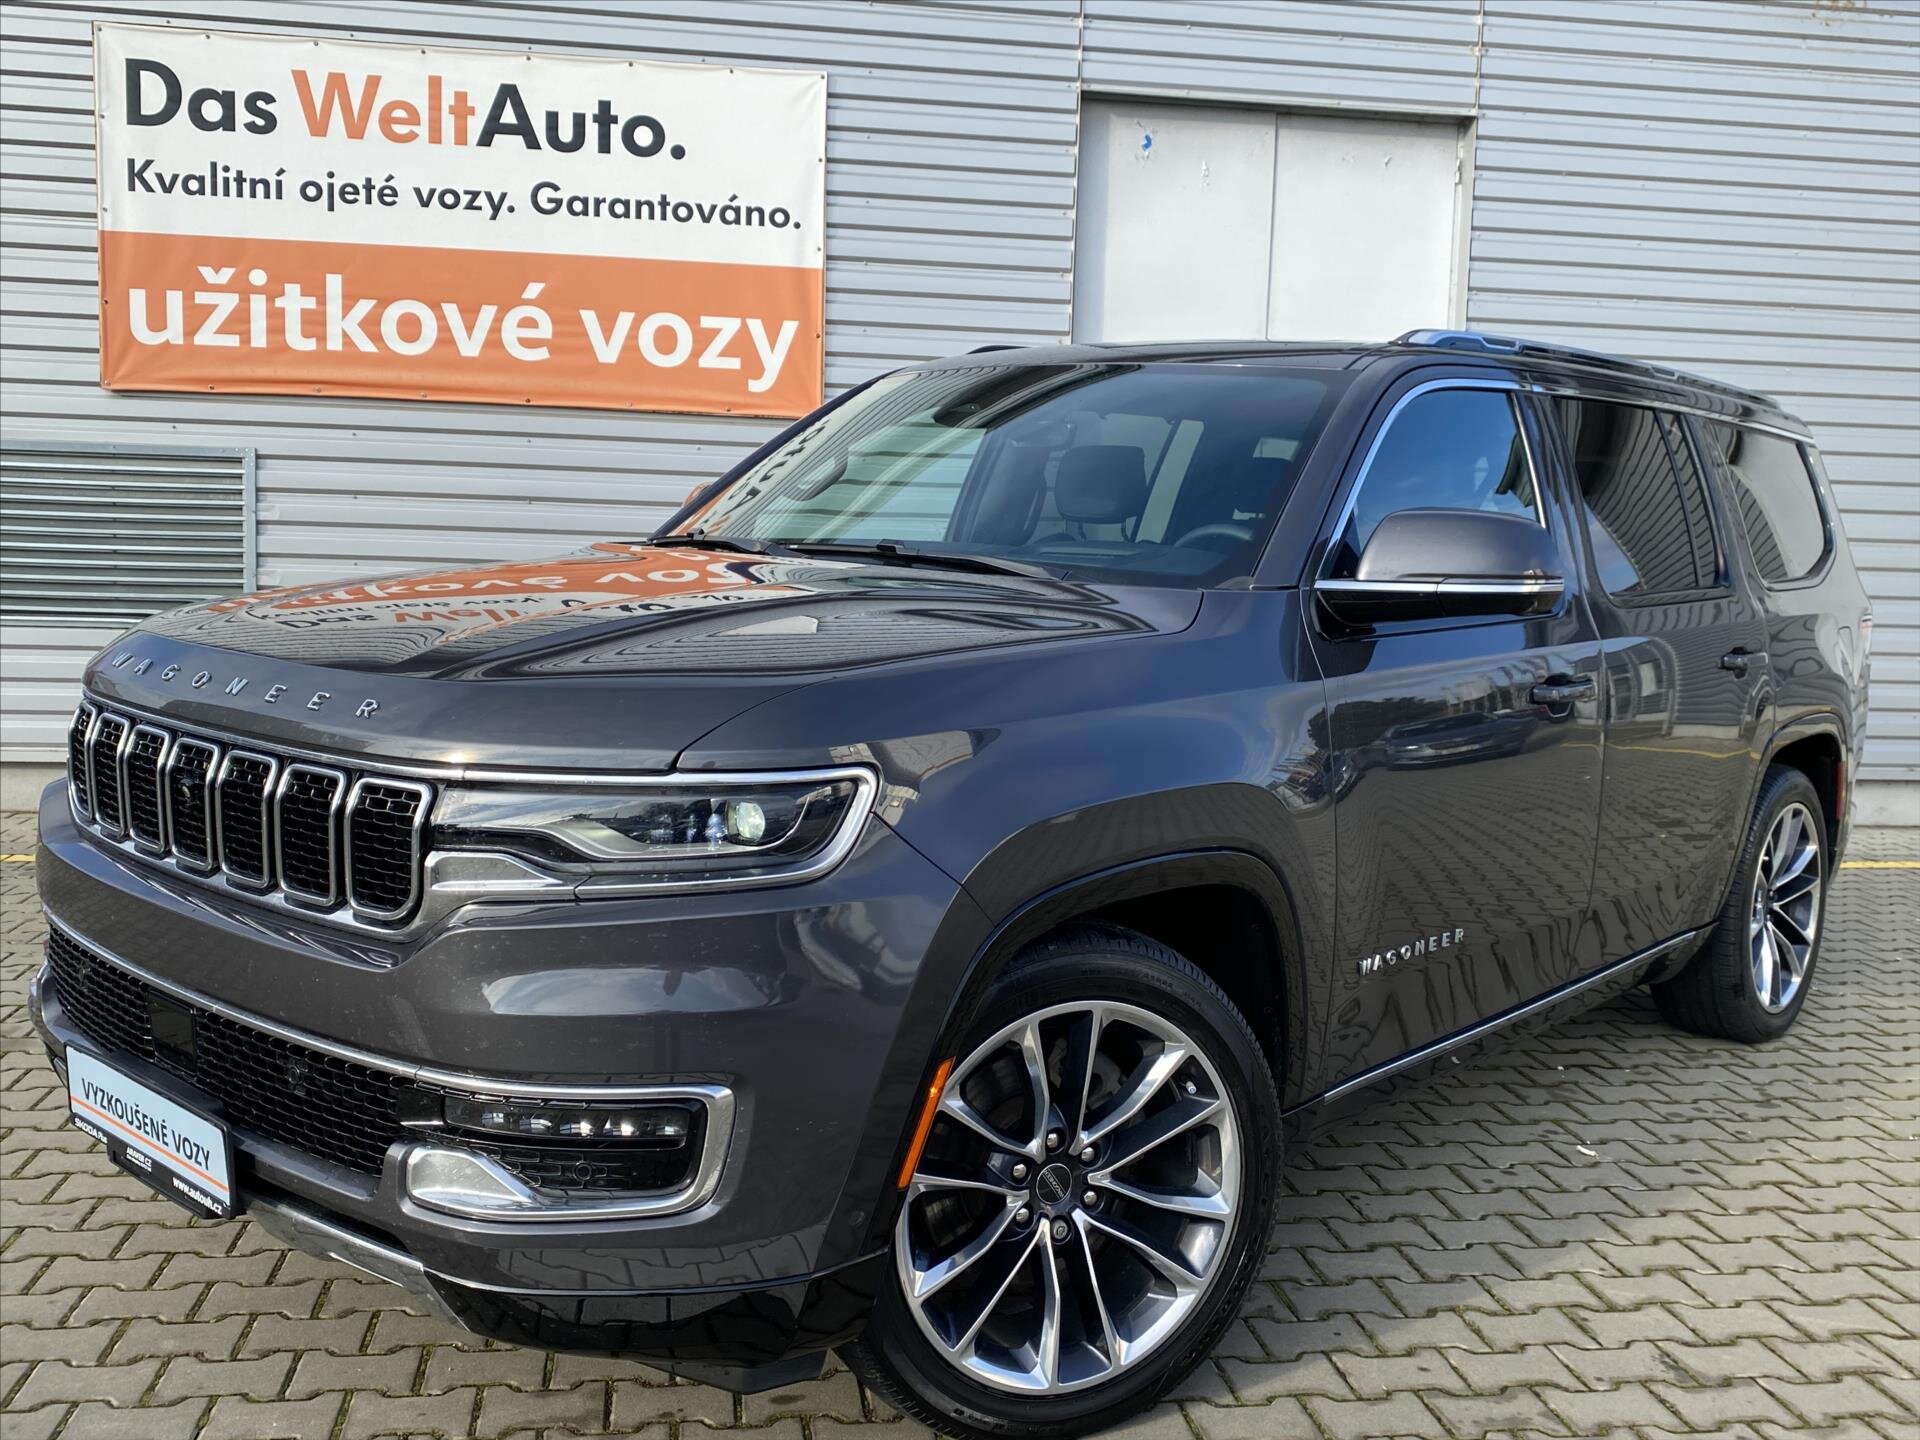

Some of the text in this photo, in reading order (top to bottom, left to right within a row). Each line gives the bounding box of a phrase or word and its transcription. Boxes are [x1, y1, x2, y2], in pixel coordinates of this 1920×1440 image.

[125, 58, 686, 160] Das WeltAuto.
[127, 158, 801, 230] Kvalitní ojeté vozy. Garantováno.
[128, 265, 799, 393] užitkové vozy
[111, 652, 380, 719] WAGONEER
[1359, 928, 1464, 976] WAGONEER
[81, 1078, 210, 1171] VYZKOUŠENÉ VOZY
